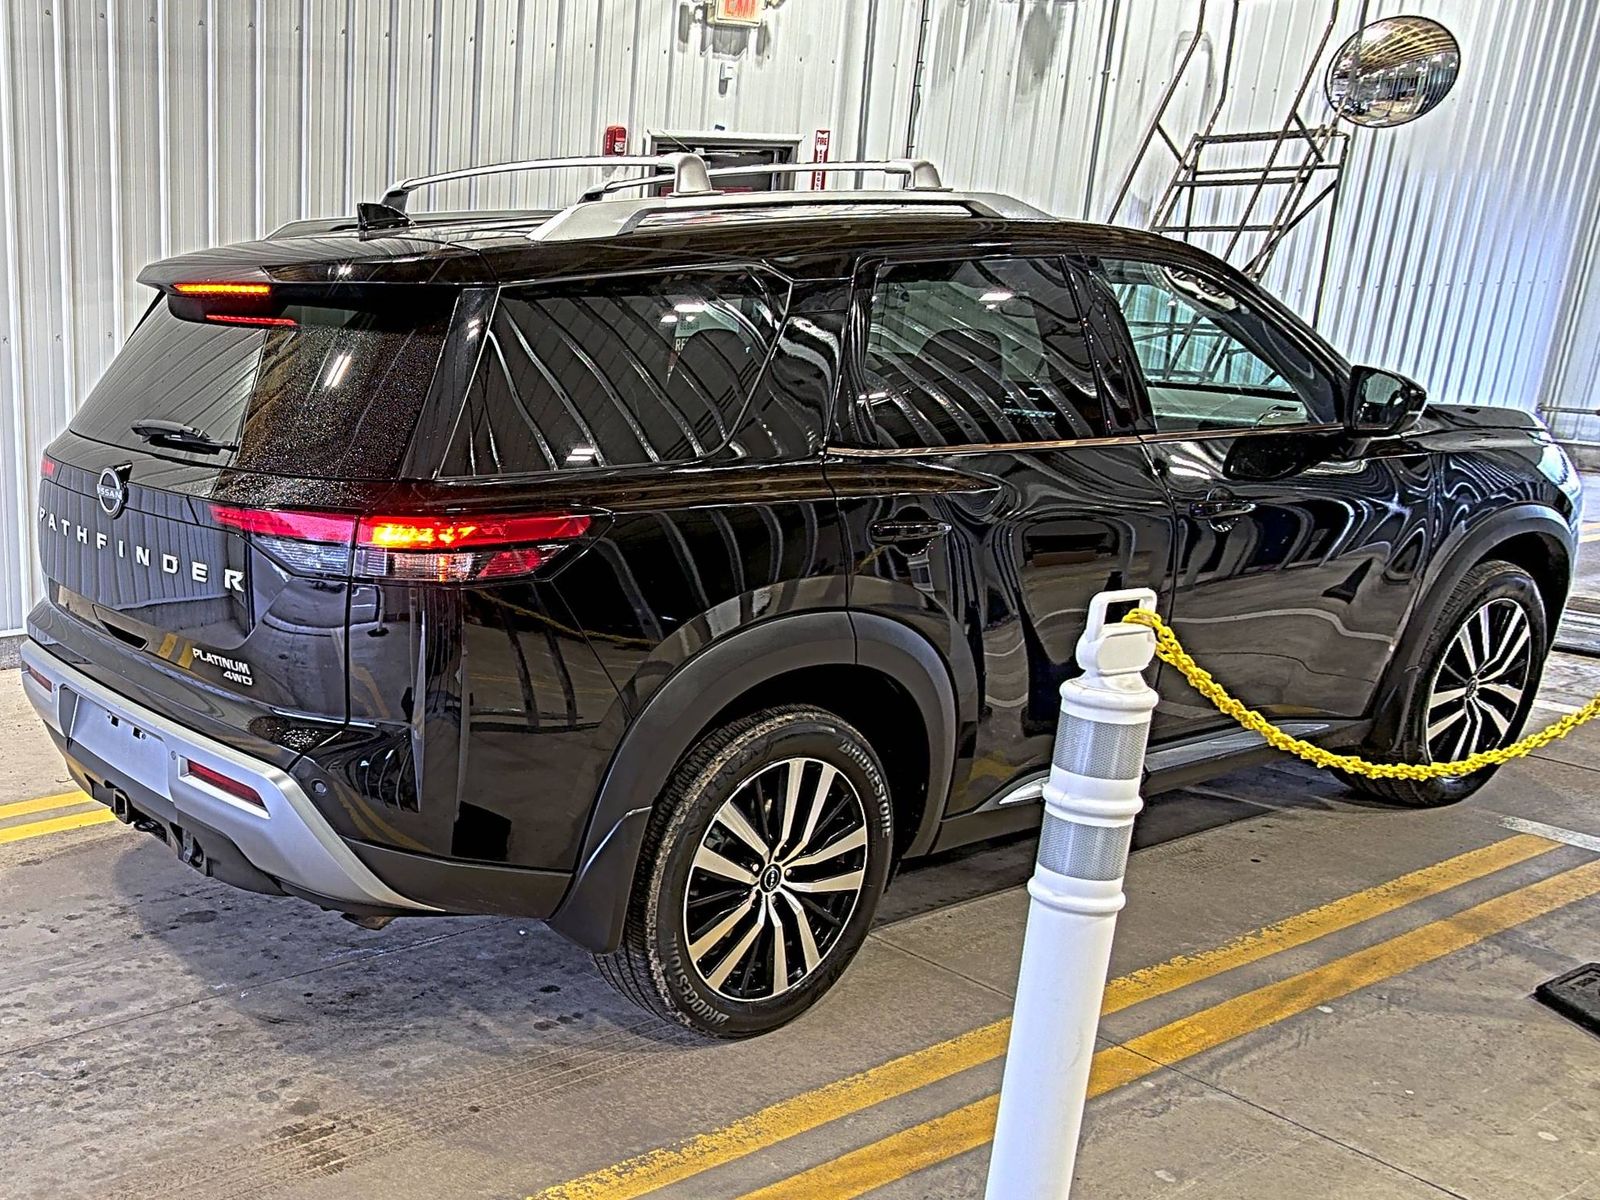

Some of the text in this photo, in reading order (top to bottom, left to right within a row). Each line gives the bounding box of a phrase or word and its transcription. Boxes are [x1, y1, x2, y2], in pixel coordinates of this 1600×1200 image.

[817, 137, 828, 146] FIRE
[38, 506, 245, 593] PATHFINDER
[192, 648, 250, 675] PLATINUM
[223, 671, 253, 686] 4WD
[838, 738, 892, 838] BRIDGESTONE
